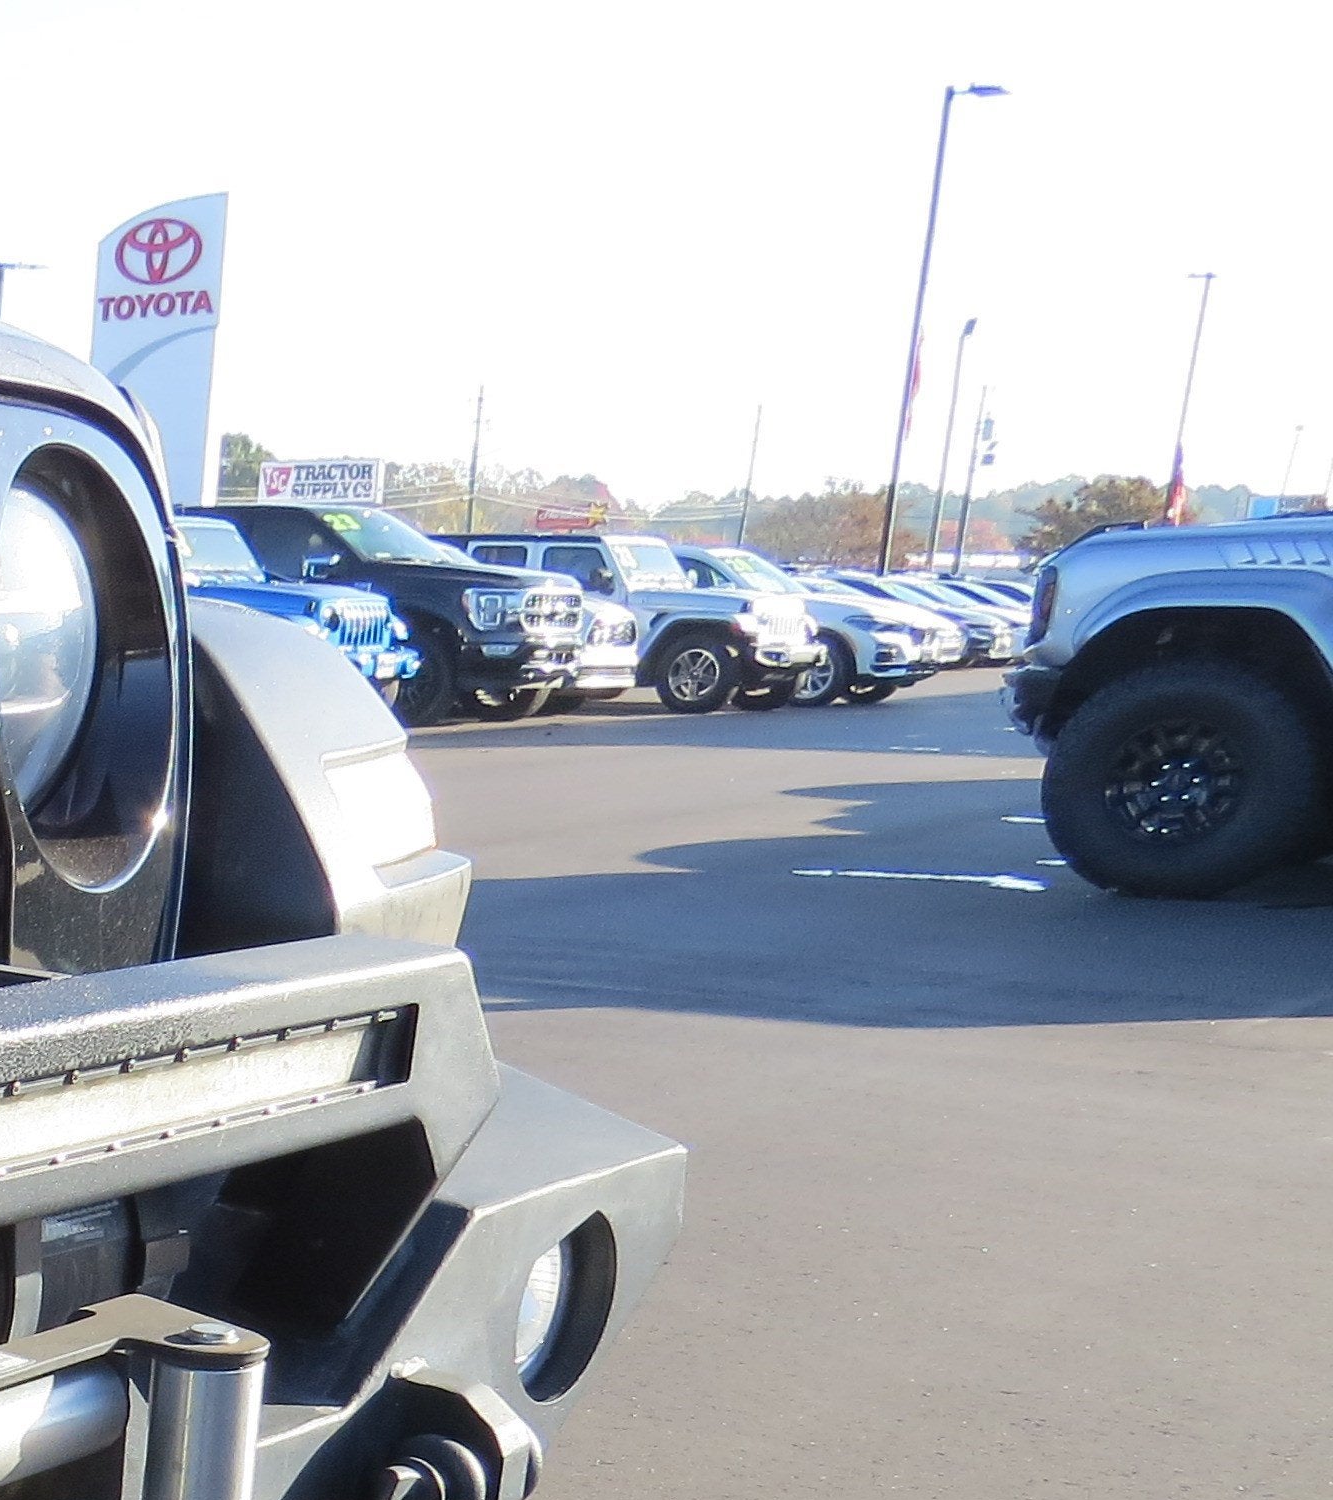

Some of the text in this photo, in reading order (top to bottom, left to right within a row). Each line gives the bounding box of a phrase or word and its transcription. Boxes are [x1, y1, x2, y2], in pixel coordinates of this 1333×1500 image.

[97, 290, 213, 322] TOYOTA
[293, 463, 373, 481] TRACTOR
[292, 481, 352, 499] SUPPLY
